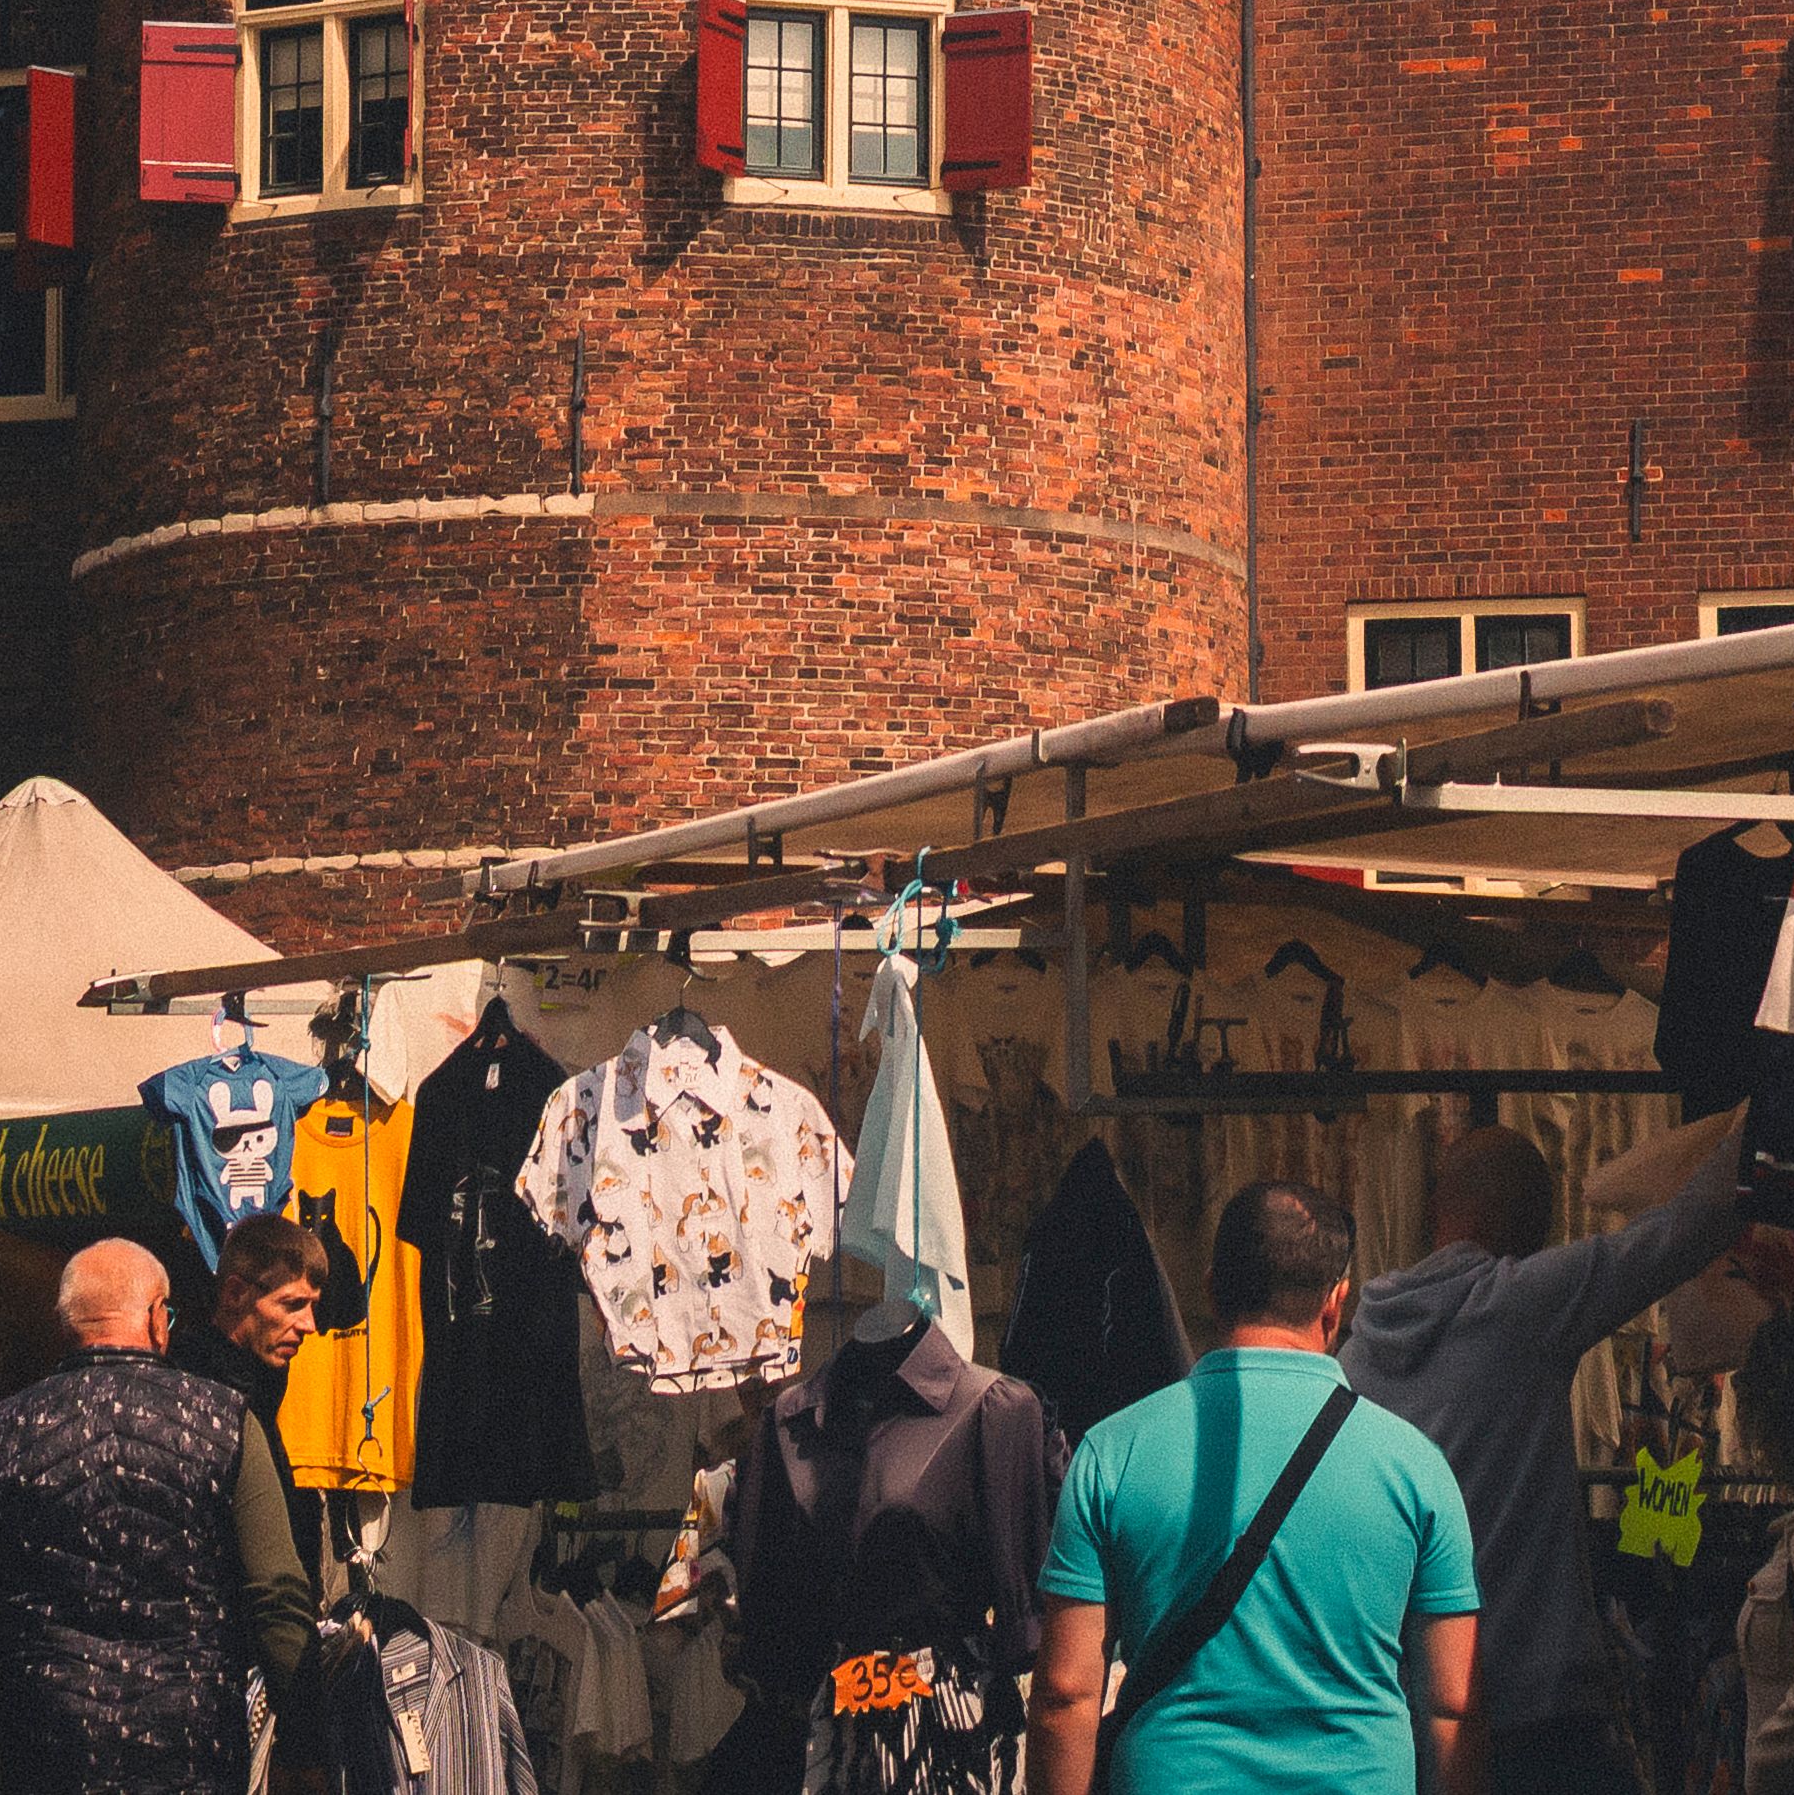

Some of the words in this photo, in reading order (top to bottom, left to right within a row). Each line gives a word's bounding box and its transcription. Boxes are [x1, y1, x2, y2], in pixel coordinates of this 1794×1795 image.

[11, 1123, 107, 1216] cheese
[1638, 1466, 1692, 1518] WOMEN
[850, 1656, 918, 1702] 35€
